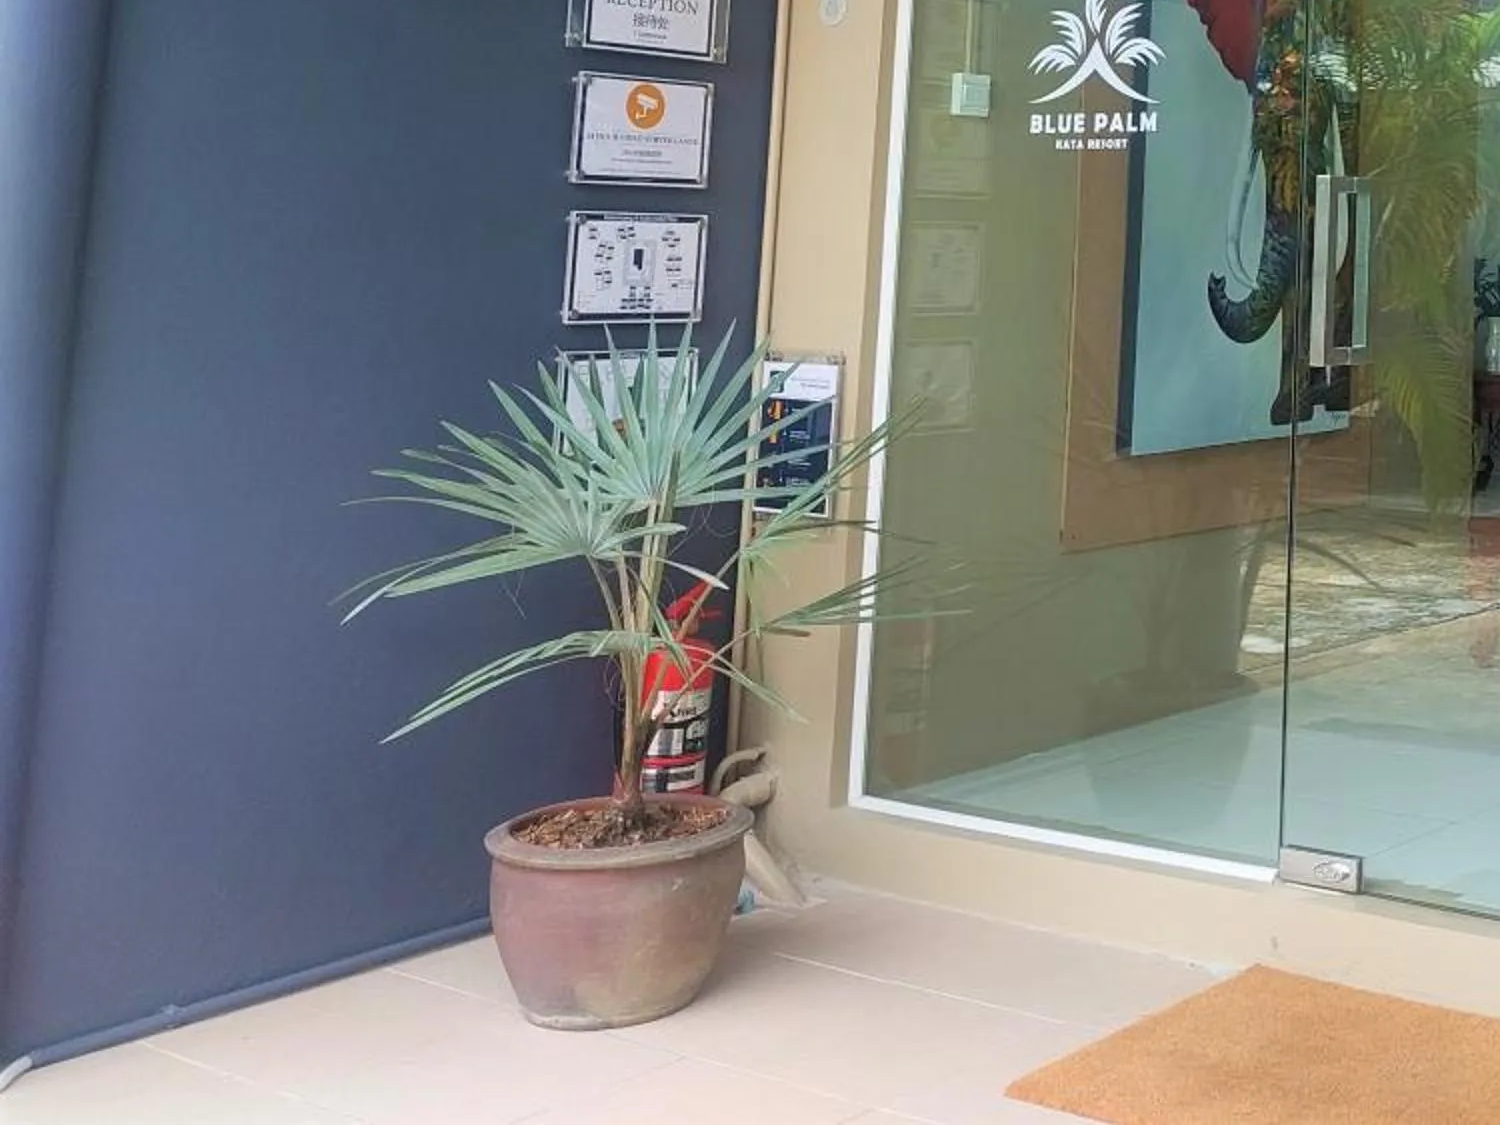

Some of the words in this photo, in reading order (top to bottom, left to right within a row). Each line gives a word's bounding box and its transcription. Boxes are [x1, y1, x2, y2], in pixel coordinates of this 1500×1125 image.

[1029, 113, 1085, 133] BLUE
[1094, 111, 1158, 132] PALM
[1055, 138, 1084, 150] KATA
[1087, 137, 1129, 150] RESORT
